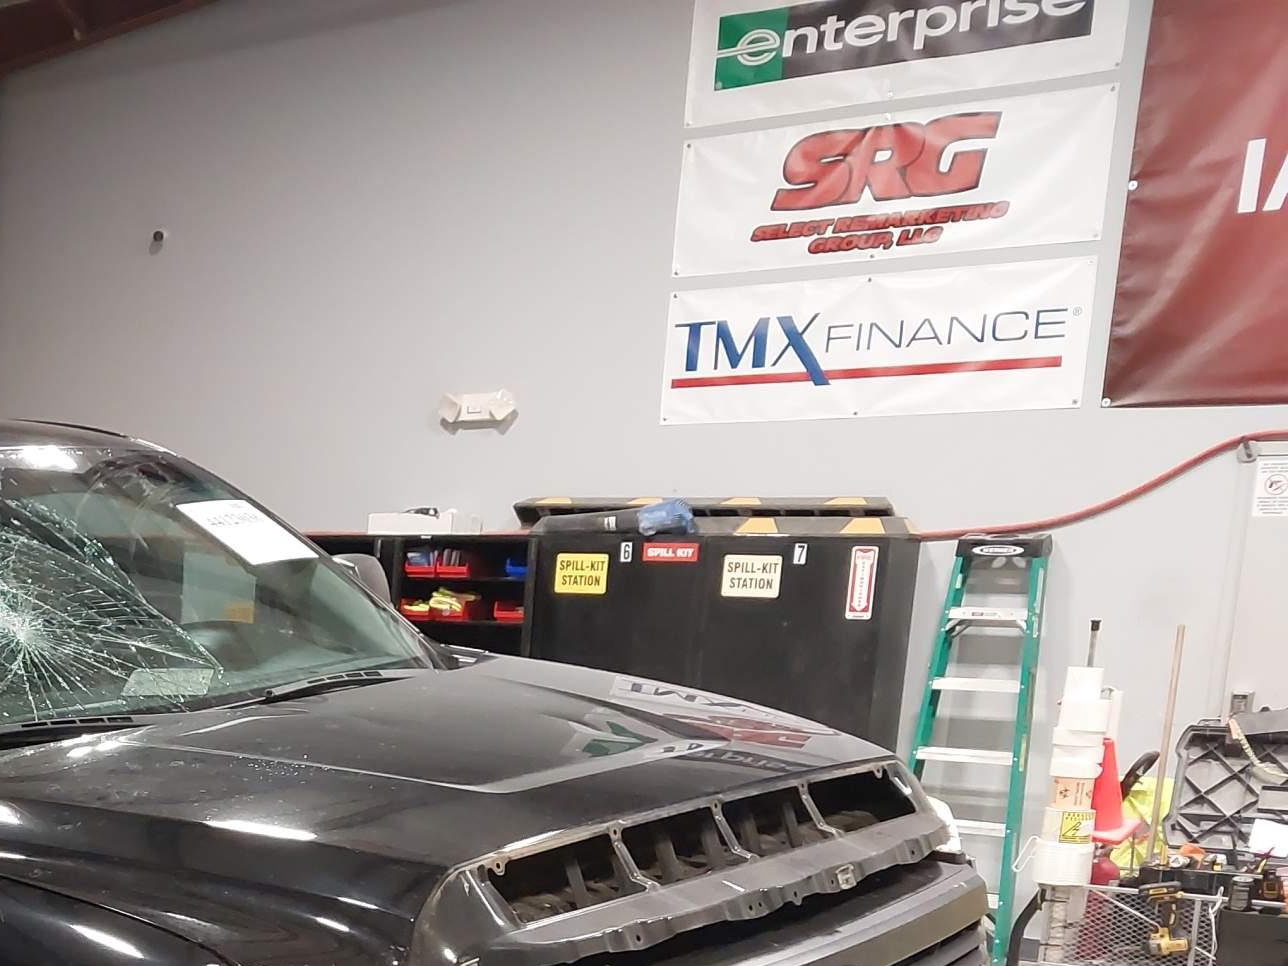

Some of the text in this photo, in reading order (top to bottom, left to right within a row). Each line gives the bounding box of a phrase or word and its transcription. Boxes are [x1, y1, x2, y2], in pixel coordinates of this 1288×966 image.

[770, 111, 1003, 211] SRG
[750, 200, 1010, 241] SELECT REMARKETING
[674, 312, 831, 386] TMX
[623, 544, 630, 560] 6
[647, 548, 694, 557] SPILL KIT
[796, 545, 806, 562] 7
[559, 560, 606, 572] SPILL-KIT
[727, 561, 780, 574] SPILL-KIT
[561, 575, 601, 587] STATION
[729, 577, 774, 590] STATION
